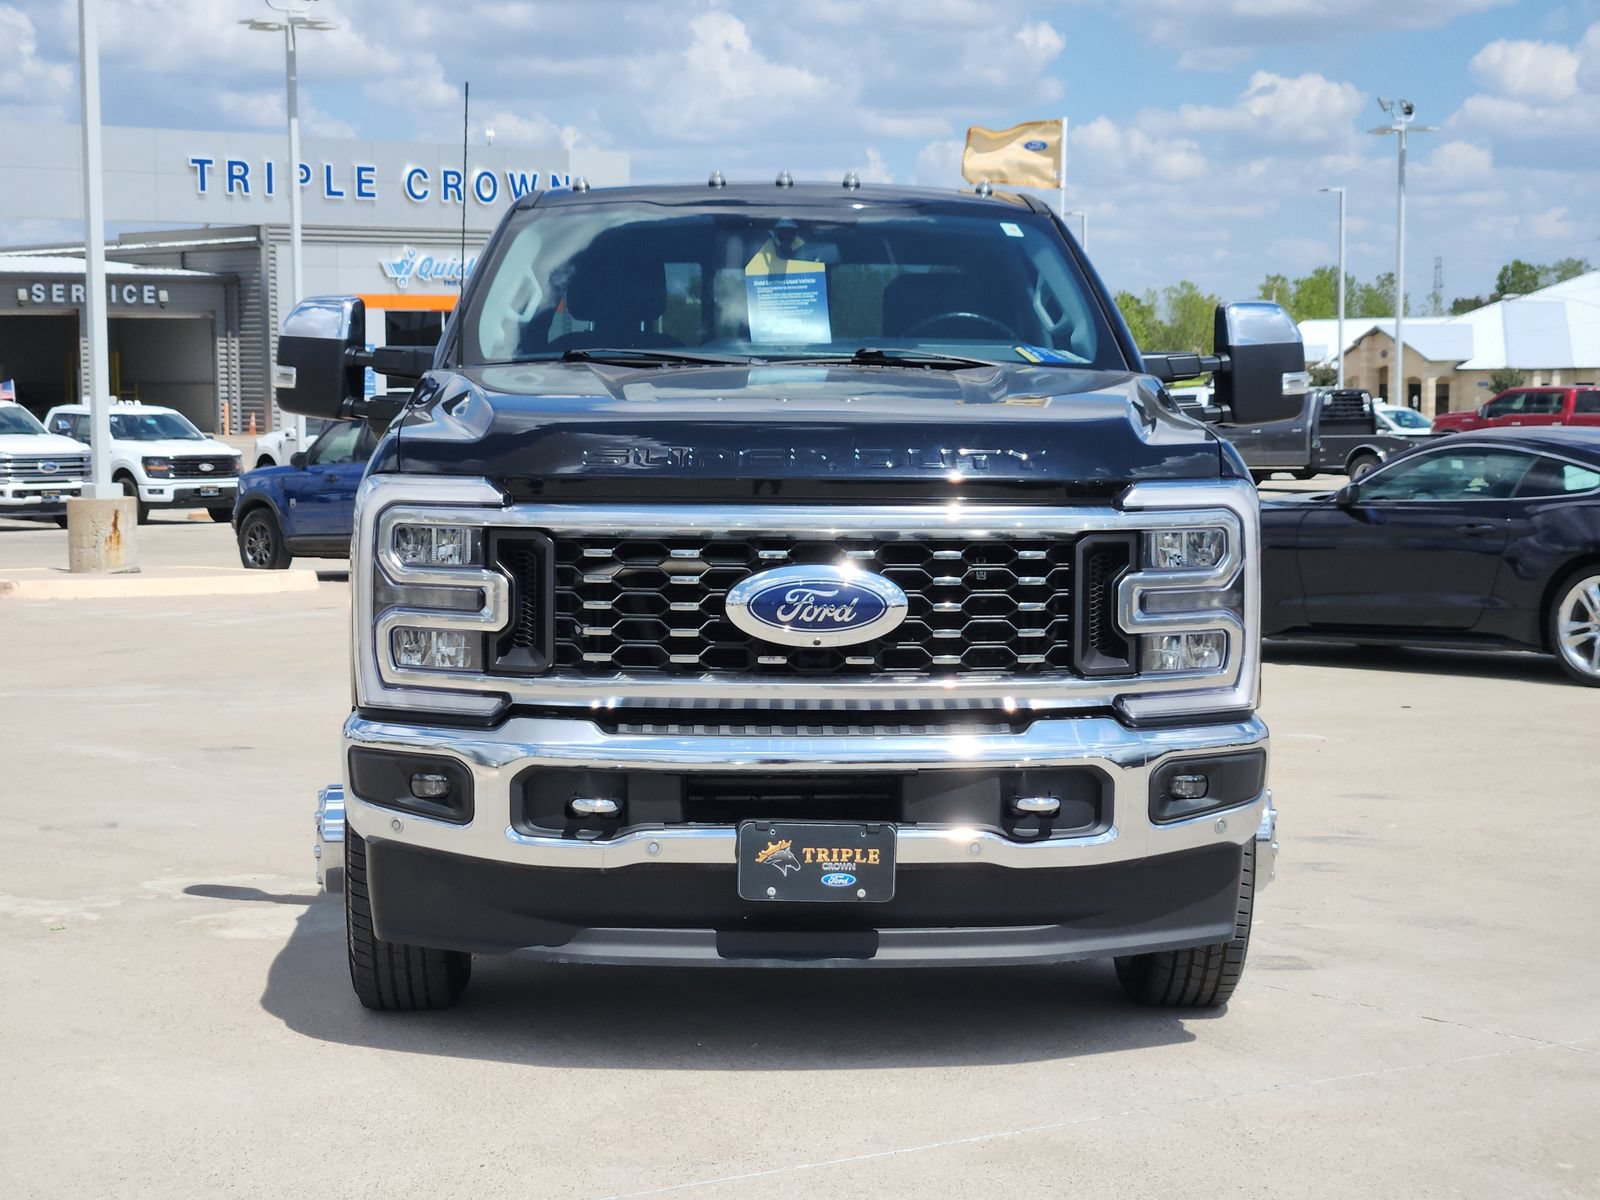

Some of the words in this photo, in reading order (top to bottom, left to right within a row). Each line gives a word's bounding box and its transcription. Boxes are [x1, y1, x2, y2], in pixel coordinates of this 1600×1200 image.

[190, 158, 376, 198] TRIPLE
[31, 283, 156, 304] SERICE
[853, 447, 1048, 470] DUTY
[776, 588, 860, 623] Ford
[802, 847, 880, 865] TRIPLE
[821, 862, 856, 871] CROWN
